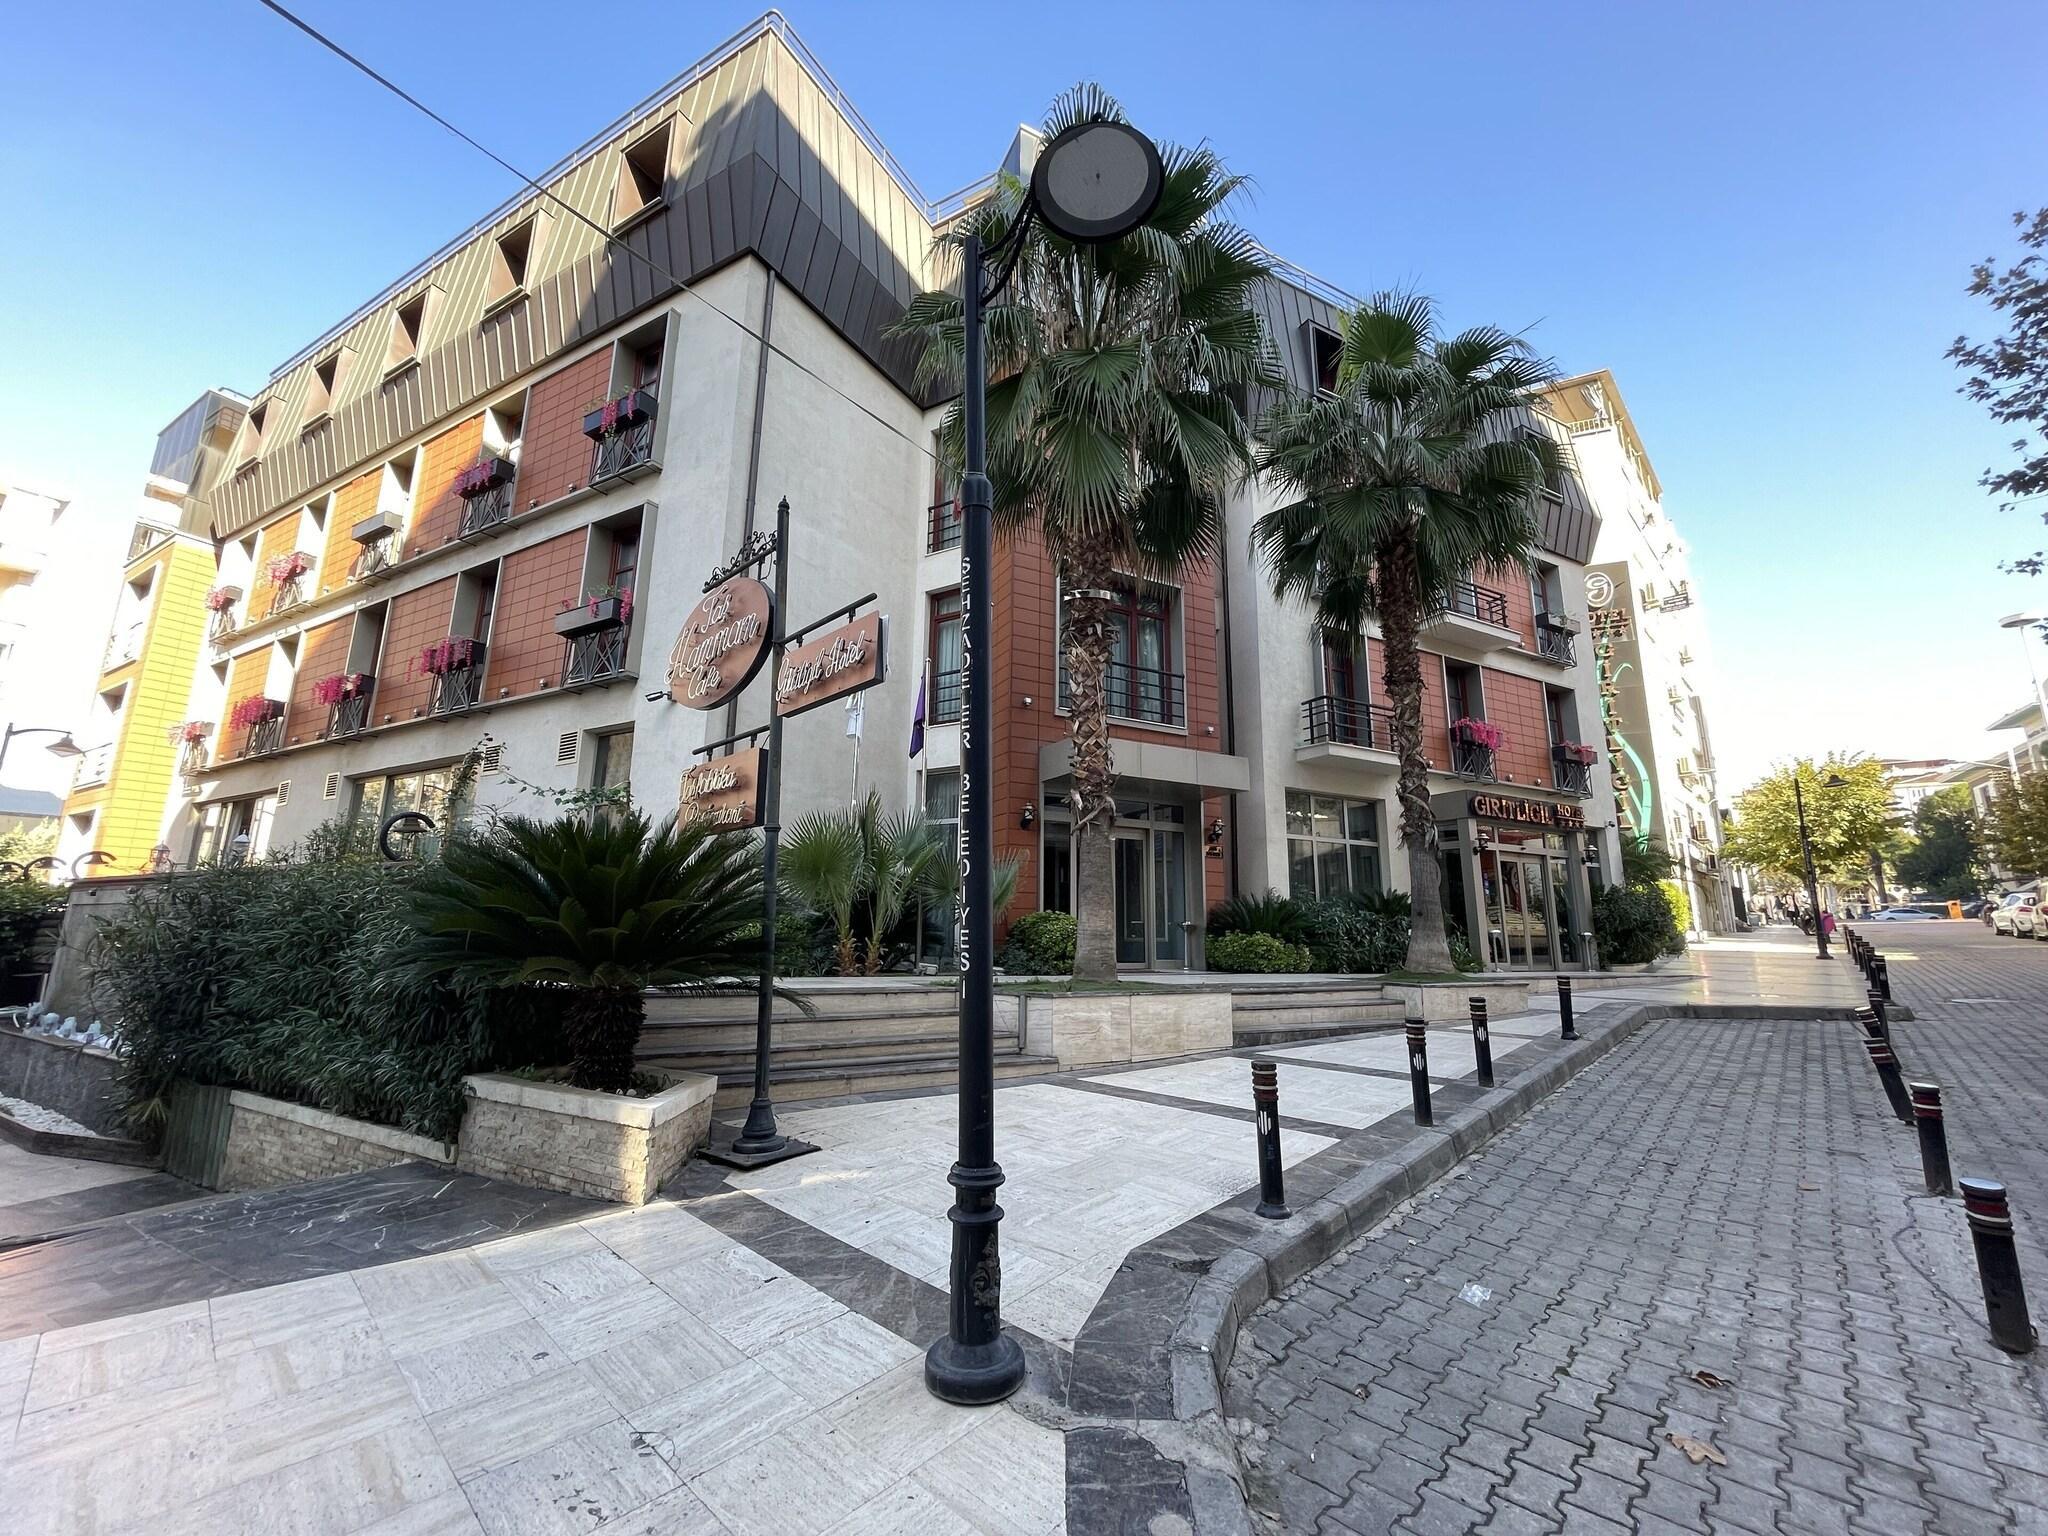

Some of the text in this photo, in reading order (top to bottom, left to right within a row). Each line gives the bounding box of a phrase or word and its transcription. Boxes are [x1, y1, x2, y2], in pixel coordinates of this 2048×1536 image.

[664, 612, 760, 684] Hammam
[825, 630, 866, 678] Hotel
[688, 664, 721, 699] Cafe
[1556, 803, 1584, 818] HOTEL
